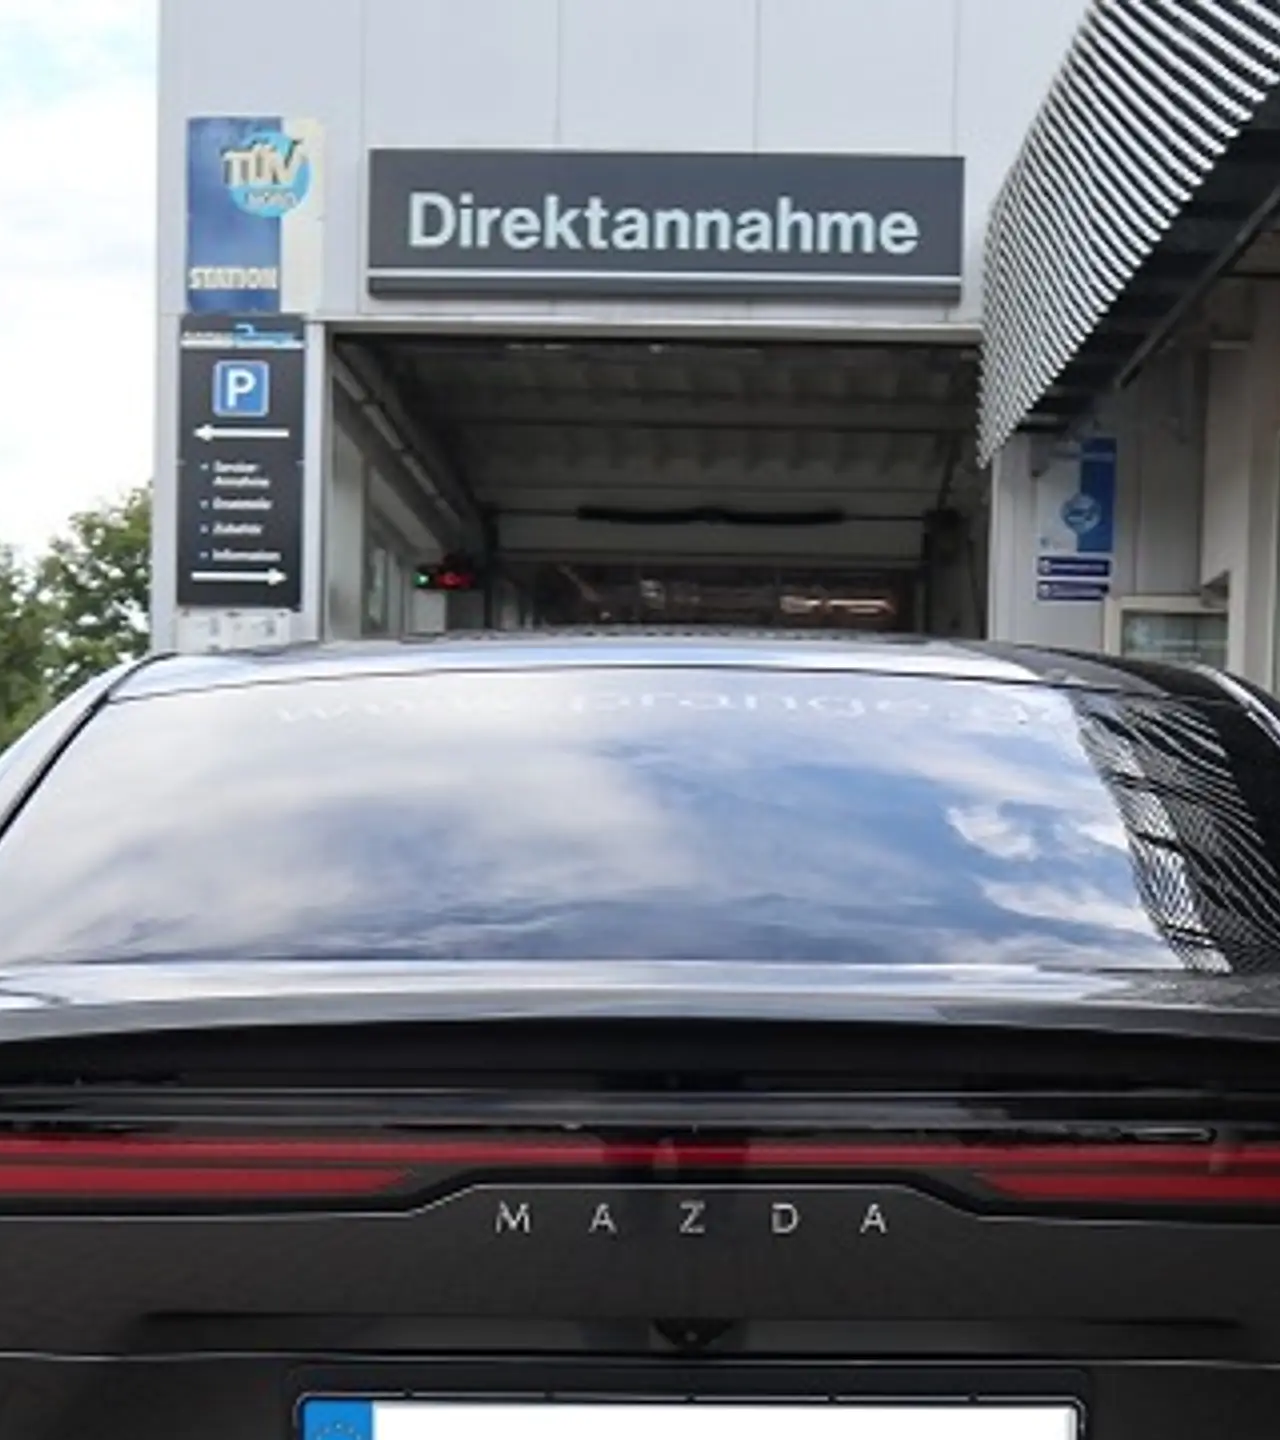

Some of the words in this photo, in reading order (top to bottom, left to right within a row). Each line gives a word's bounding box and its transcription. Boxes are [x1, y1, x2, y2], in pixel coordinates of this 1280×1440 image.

[222, 139, 303, 187] TÜV
[408, 191, 920, 255] Direktannahme
[189, 266, 278, 290] STATION
[227, 368, 258, 408] P
[494, 1202, 888, 1234] MAZDA
